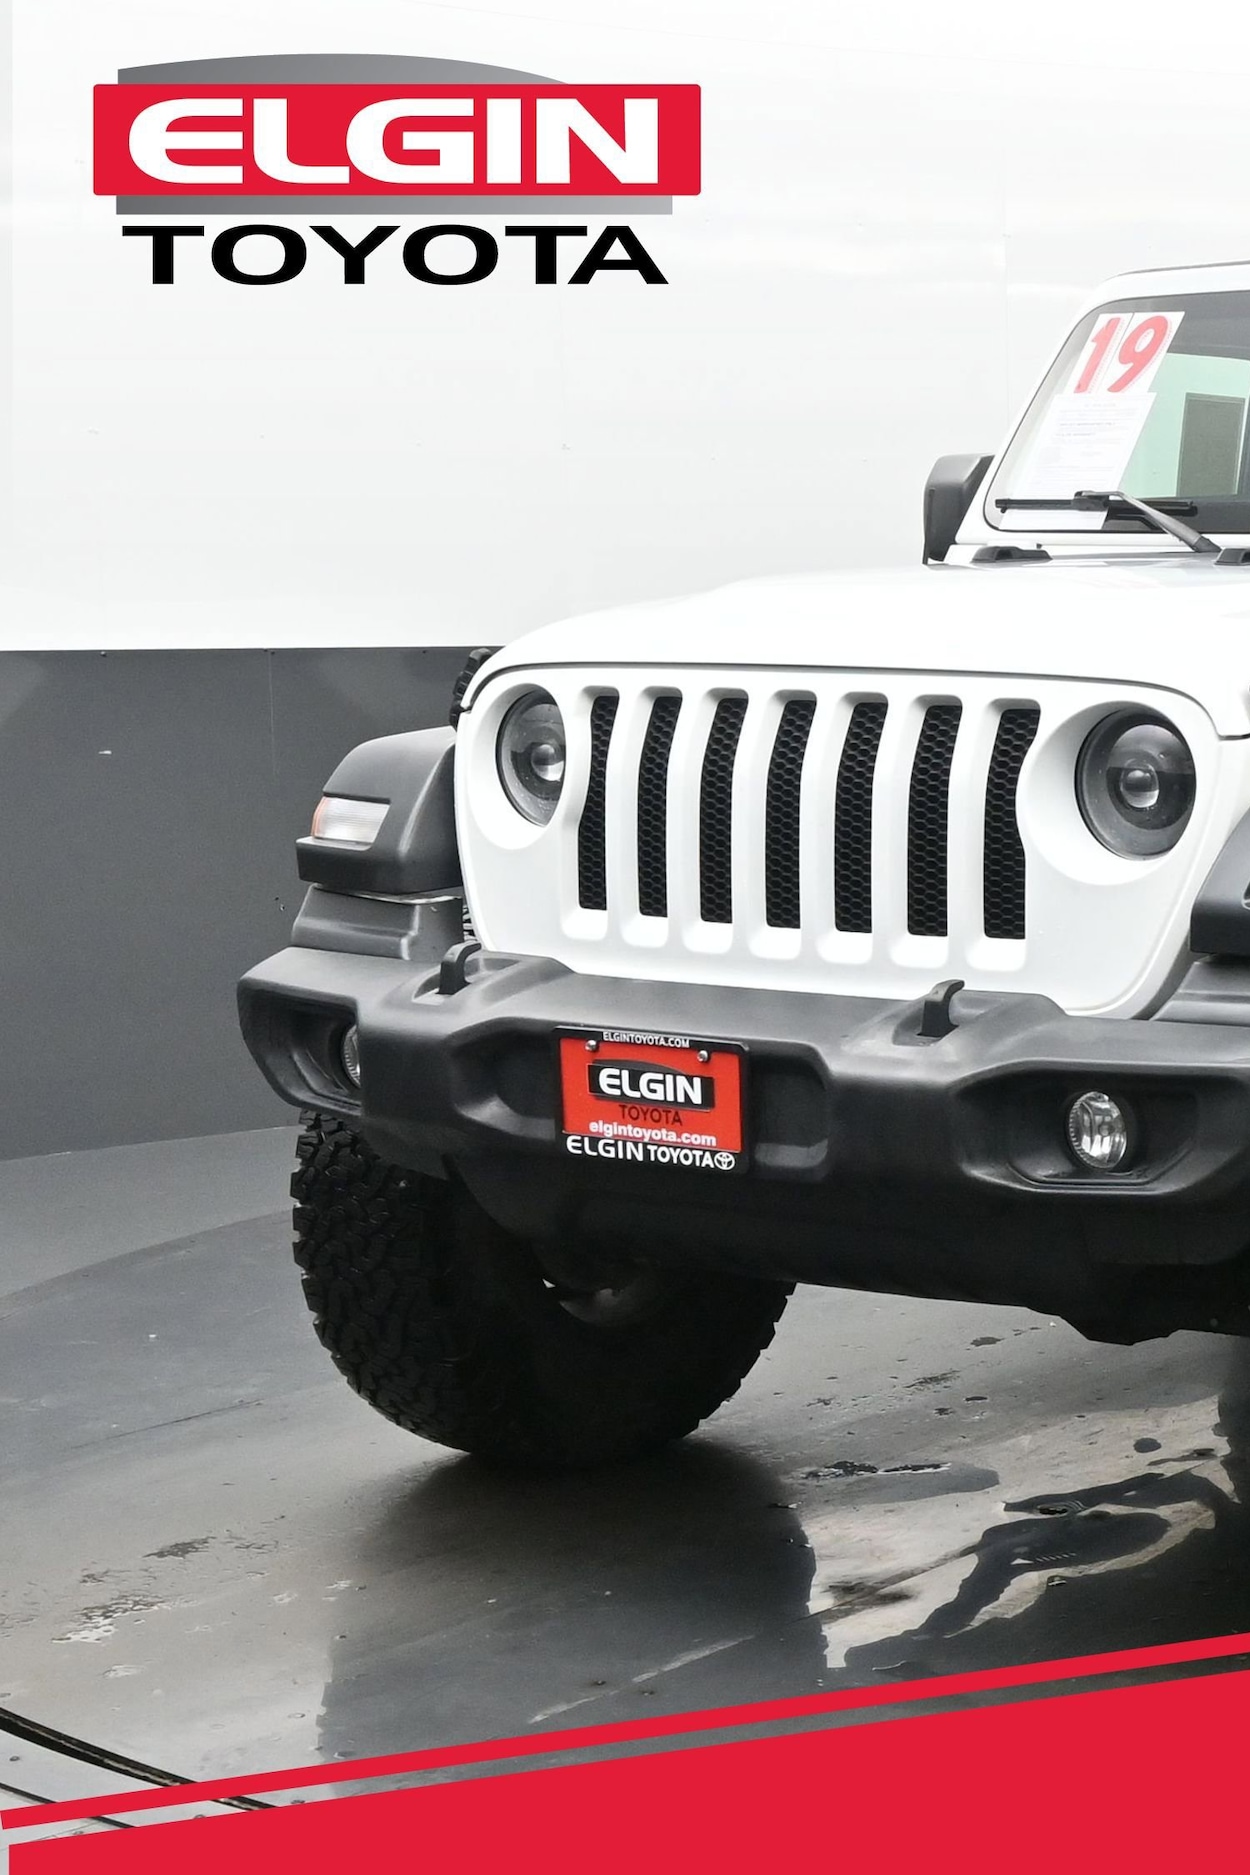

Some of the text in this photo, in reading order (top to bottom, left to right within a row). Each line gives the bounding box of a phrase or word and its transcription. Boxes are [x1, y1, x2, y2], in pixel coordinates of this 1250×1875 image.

[1073, 314, 1170, 394] 19
[602, 1031, 690, 1049] ELGINTOYOTA.COM
[598, 1067, 703, 1105] ELGIN
[618, 1104, 683, 1127] TOYOTA
[588, 1120, 717, 1147] elgintoyota.com
[566, 1135, 715, 1169] ELGIN TOYOTA
